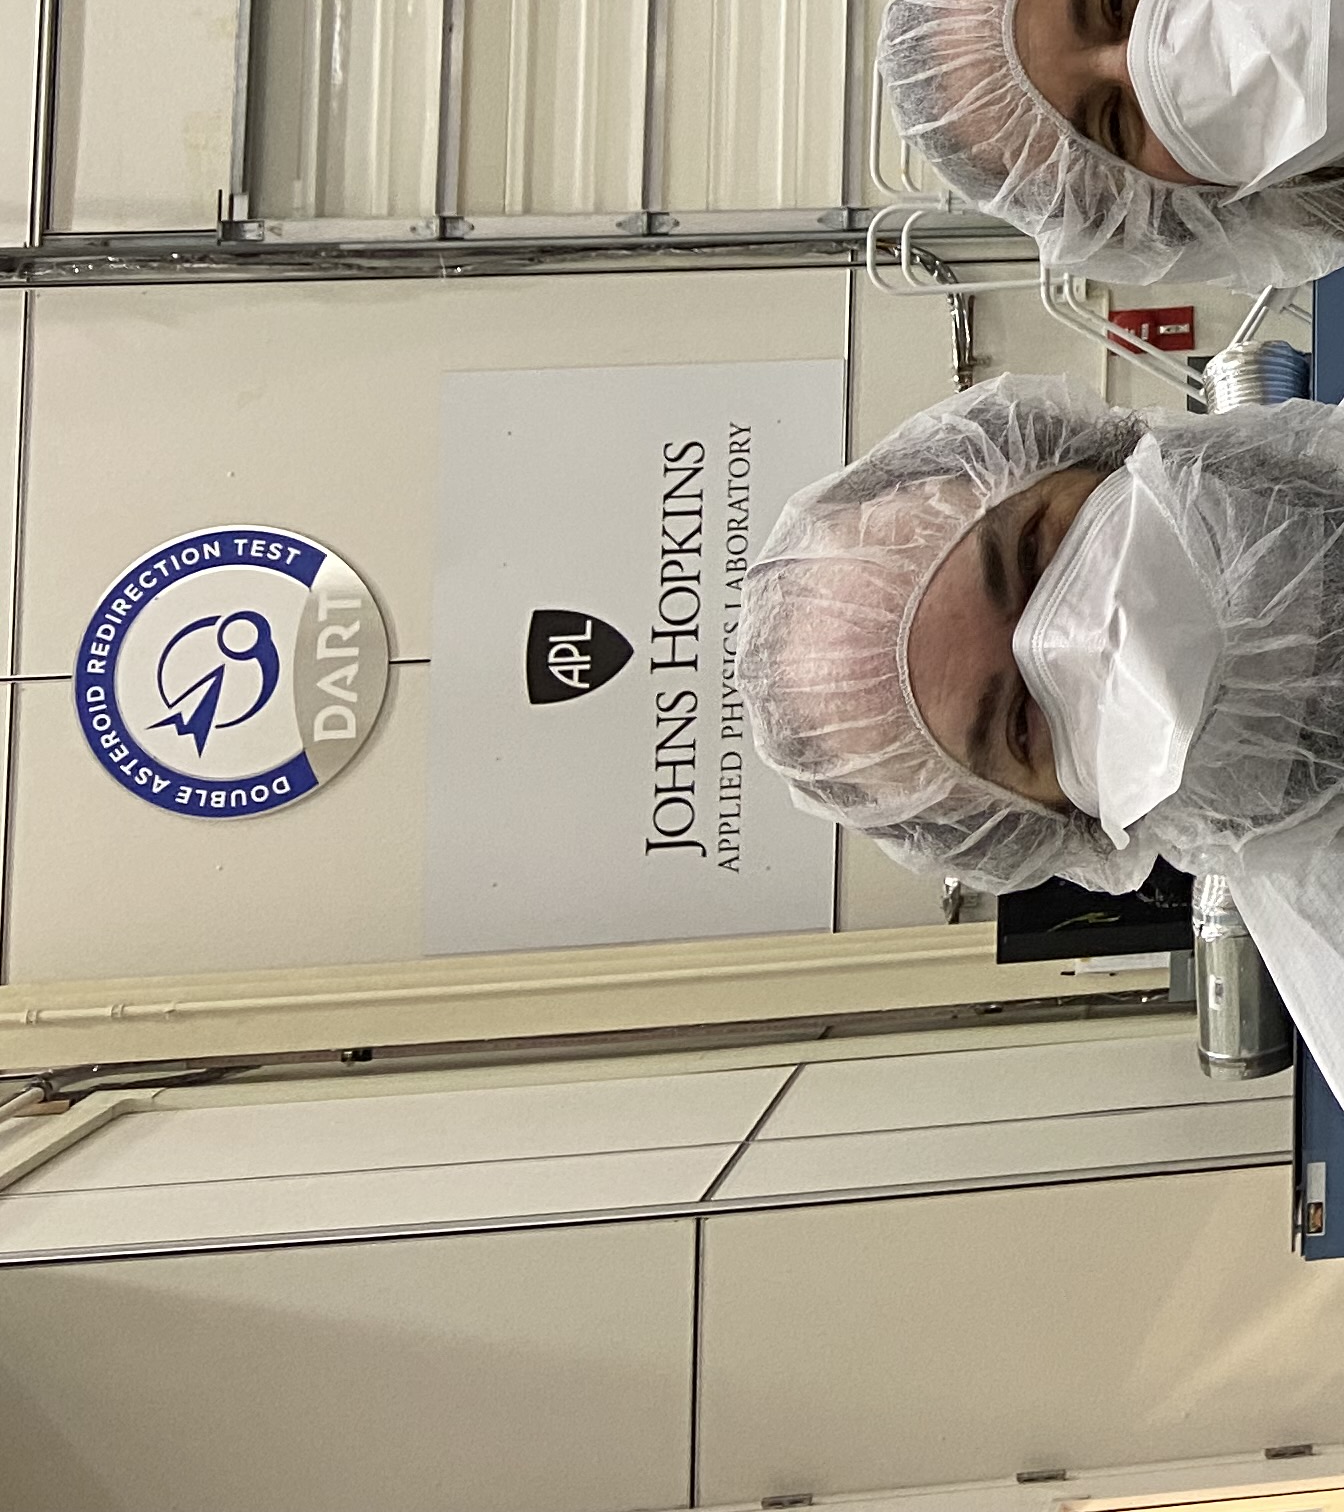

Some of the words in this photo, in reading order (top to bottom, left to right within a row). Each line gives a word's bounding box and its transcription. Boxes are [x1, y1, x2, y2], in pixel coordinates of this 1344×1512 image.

[86, 540, 221, 674] REDIRECTION
[233, 538, 302, 565] TEST
[650, 441, 705, 674] HOPKINS
[313, 589, 362, 742] DART
[547, 619, 592, 689] APL
[85, 685, 171, 794] ASTEROID
[174, 775, 291, 809] DOUBLE
[645, 690, 707, 857] JOHNS
[717, 751, 743, 874] APPLIED
